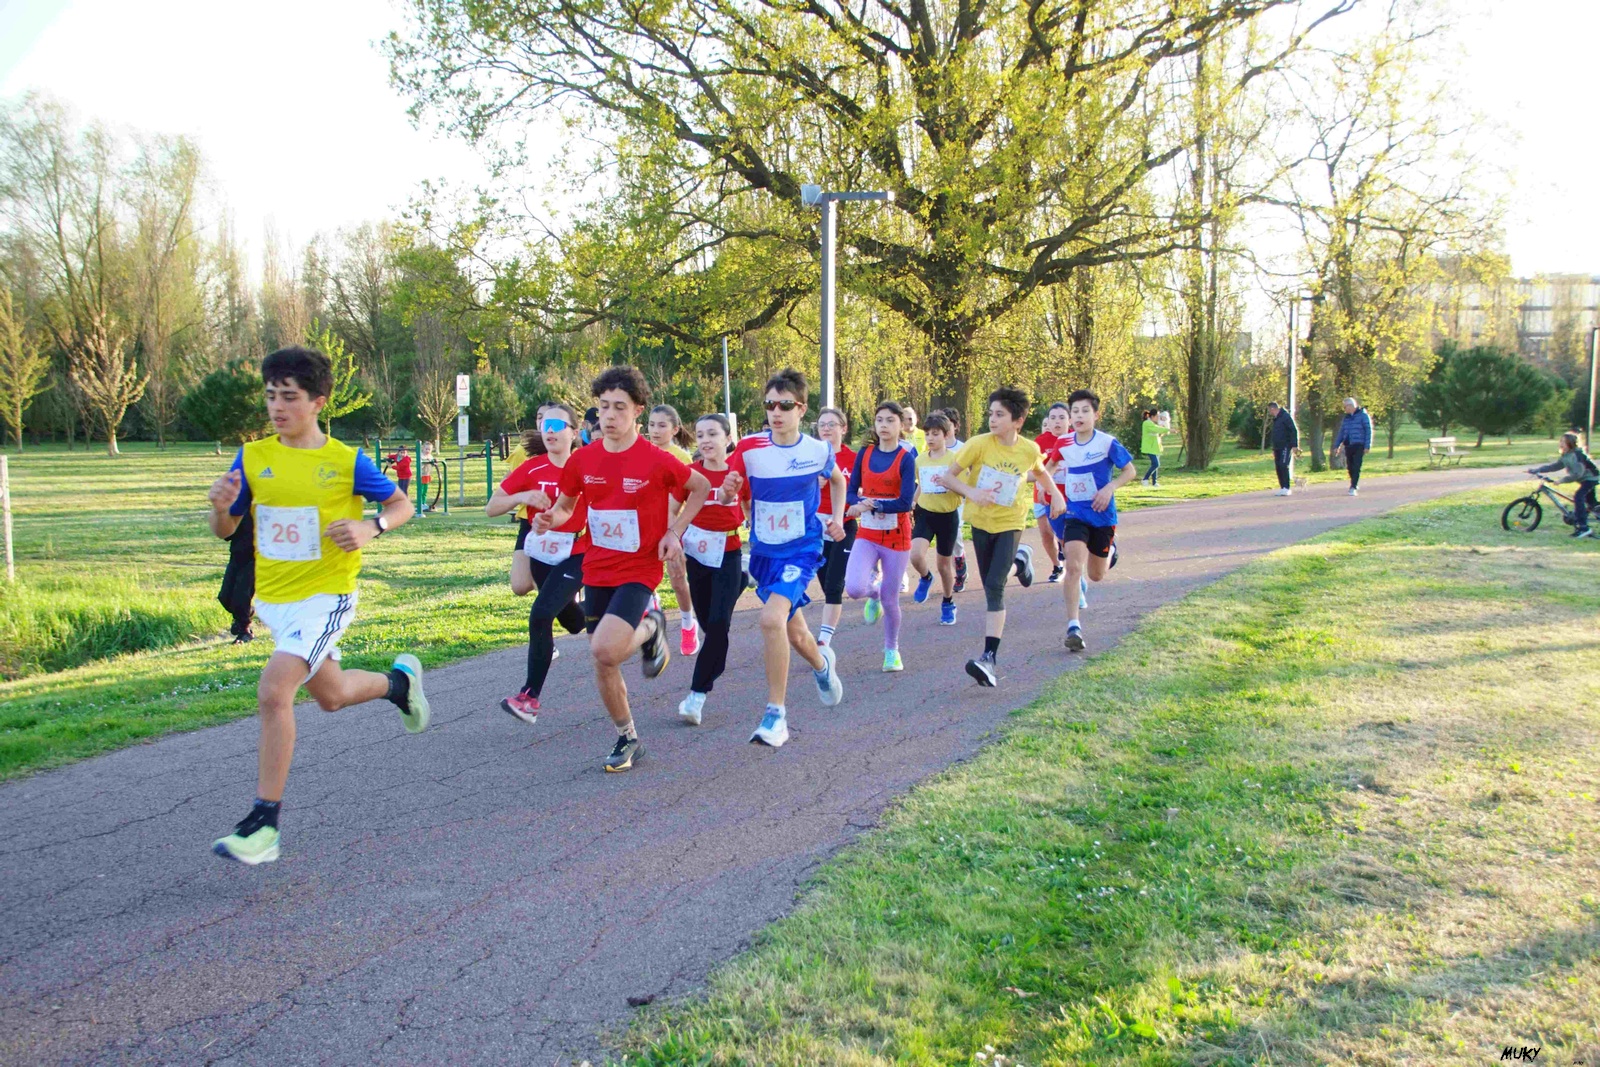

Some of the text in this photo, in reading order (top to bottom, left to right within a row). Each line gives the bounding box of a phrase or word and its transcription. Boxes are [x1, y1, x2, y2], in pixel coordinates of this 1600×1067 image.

[993, 481, 1003, 494] 2
[1072, 482, 1087, 493] 23
[601, 522, 624, 539] 24
[767, 514, 790, 531] 14
[271, 523, 301, 544] 26
[540, 539, 559, 555] 15
[697, 540, 708, 553] 8
